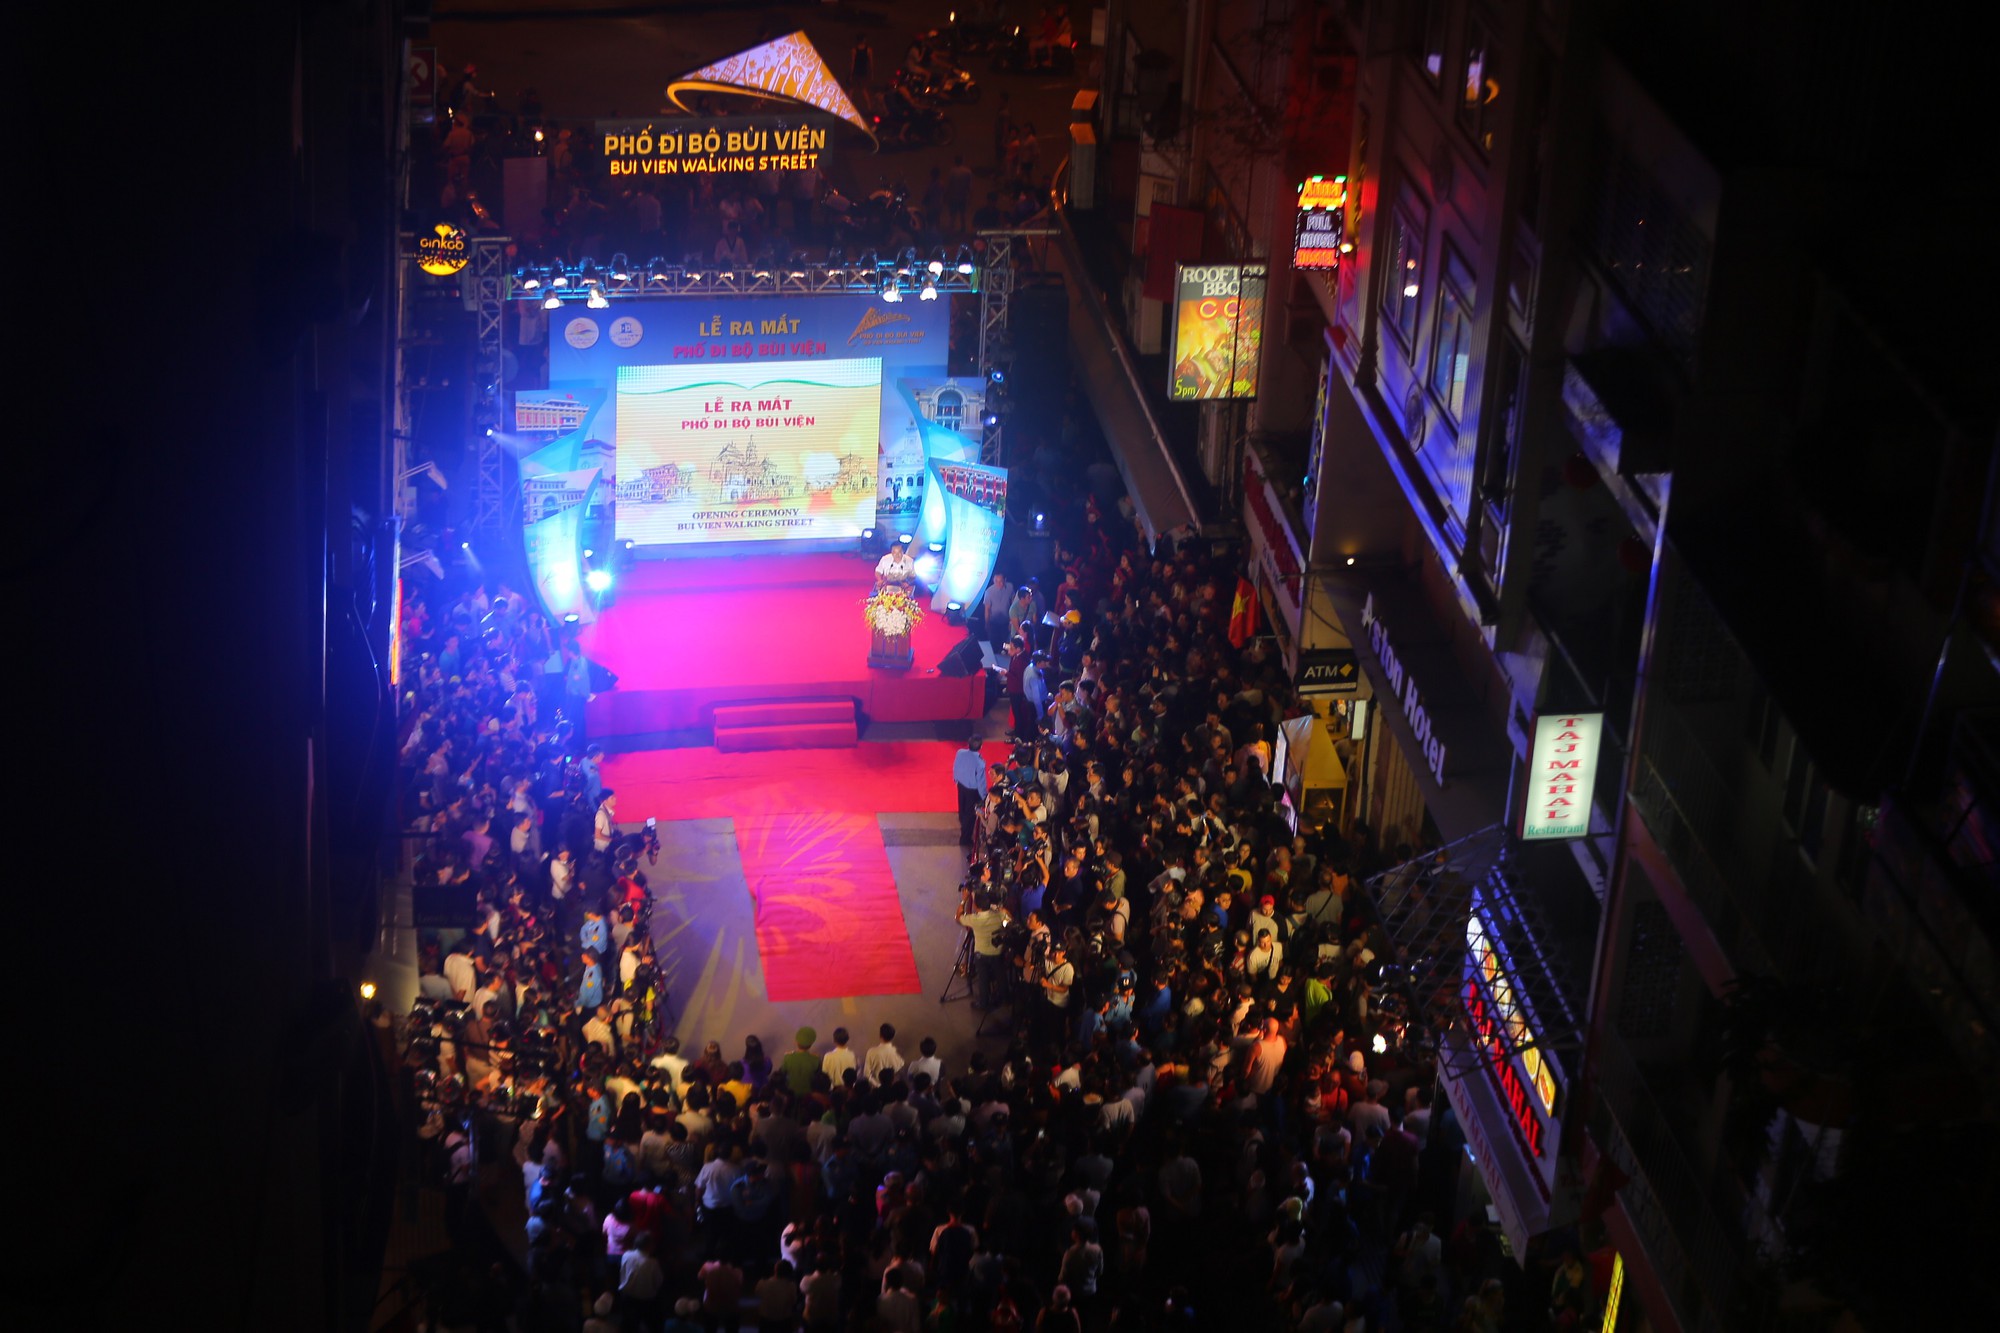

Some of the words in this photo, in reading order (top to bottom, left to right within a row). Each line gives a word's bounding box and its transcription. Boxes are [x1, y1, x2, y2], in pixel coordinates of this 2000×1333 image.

[604, 125, 653, 156] PHỐ
[658, 134, 683, 155] ĐI
[688, 127, 720, 158] BỘ
[727, 125, 768, 152] BÙI
[774, 124, 826, 154] VIỆN
[610, 159, 637, 175] BUI
[641, 158, 678, 174] VIEN
[682, 156, 755, 173] WALKING
[758, 154, 818, 171] STREET
[700, 315, 722, 337] LỄ
[730, 320, 754, 336] RA
[760, 313, 800, 335] MẮT
[673, 340, 707, 359] PHỐ
[731, 341, 753, 359] BỘ
[758, 340, 786, 357] BÙI
[790, 338, 827, 357] VIỆN
[1174, 379, 1196, 398] 5pm
[704, 396, 724, 413] LỄ
[731, 401, 752, 412] RA
[758, 395, 792, 411] MẮT
[681, 416, 710, 430] PHỐ
[732, 416, 751, 429] BỘ
[756, 415, 779, 428] BÙI
[784, 414, 815, 428] VIỆN
[692, 510, 739, 520] OPENING
[740, 508, 800, 518] CEREMONY
[677, 522, 695, 531] BUI
[697, 521, 722, 530] VIEN
[724, 520, 773, 529] WALKING
[774, 518, 814, 527] STREET
[1304, 666, 1338, 679] ATM
[1553, 718, 1583, 752] TAJ
[1545, 759, 1582, 818] MAHAL
[1527, 824, 1586, 836] Restaurant
